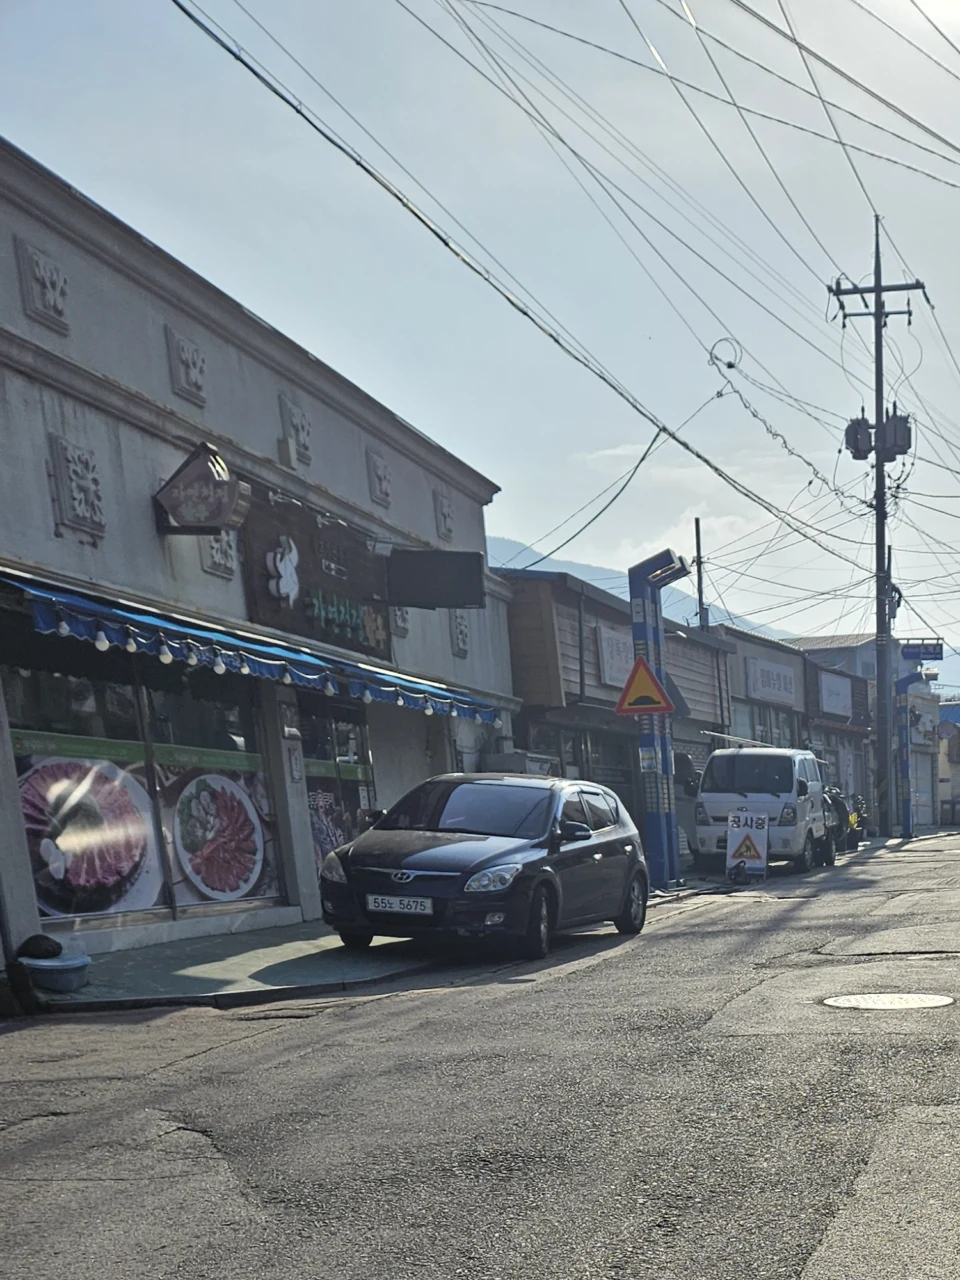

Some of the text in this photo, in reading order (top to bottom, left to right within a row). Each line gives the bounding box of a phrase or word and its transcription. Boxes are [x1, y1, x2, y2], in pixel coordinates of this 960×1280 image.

[731, 815, 766, 830] 공사중
[373, 897, 426, 911] 55노 5675
